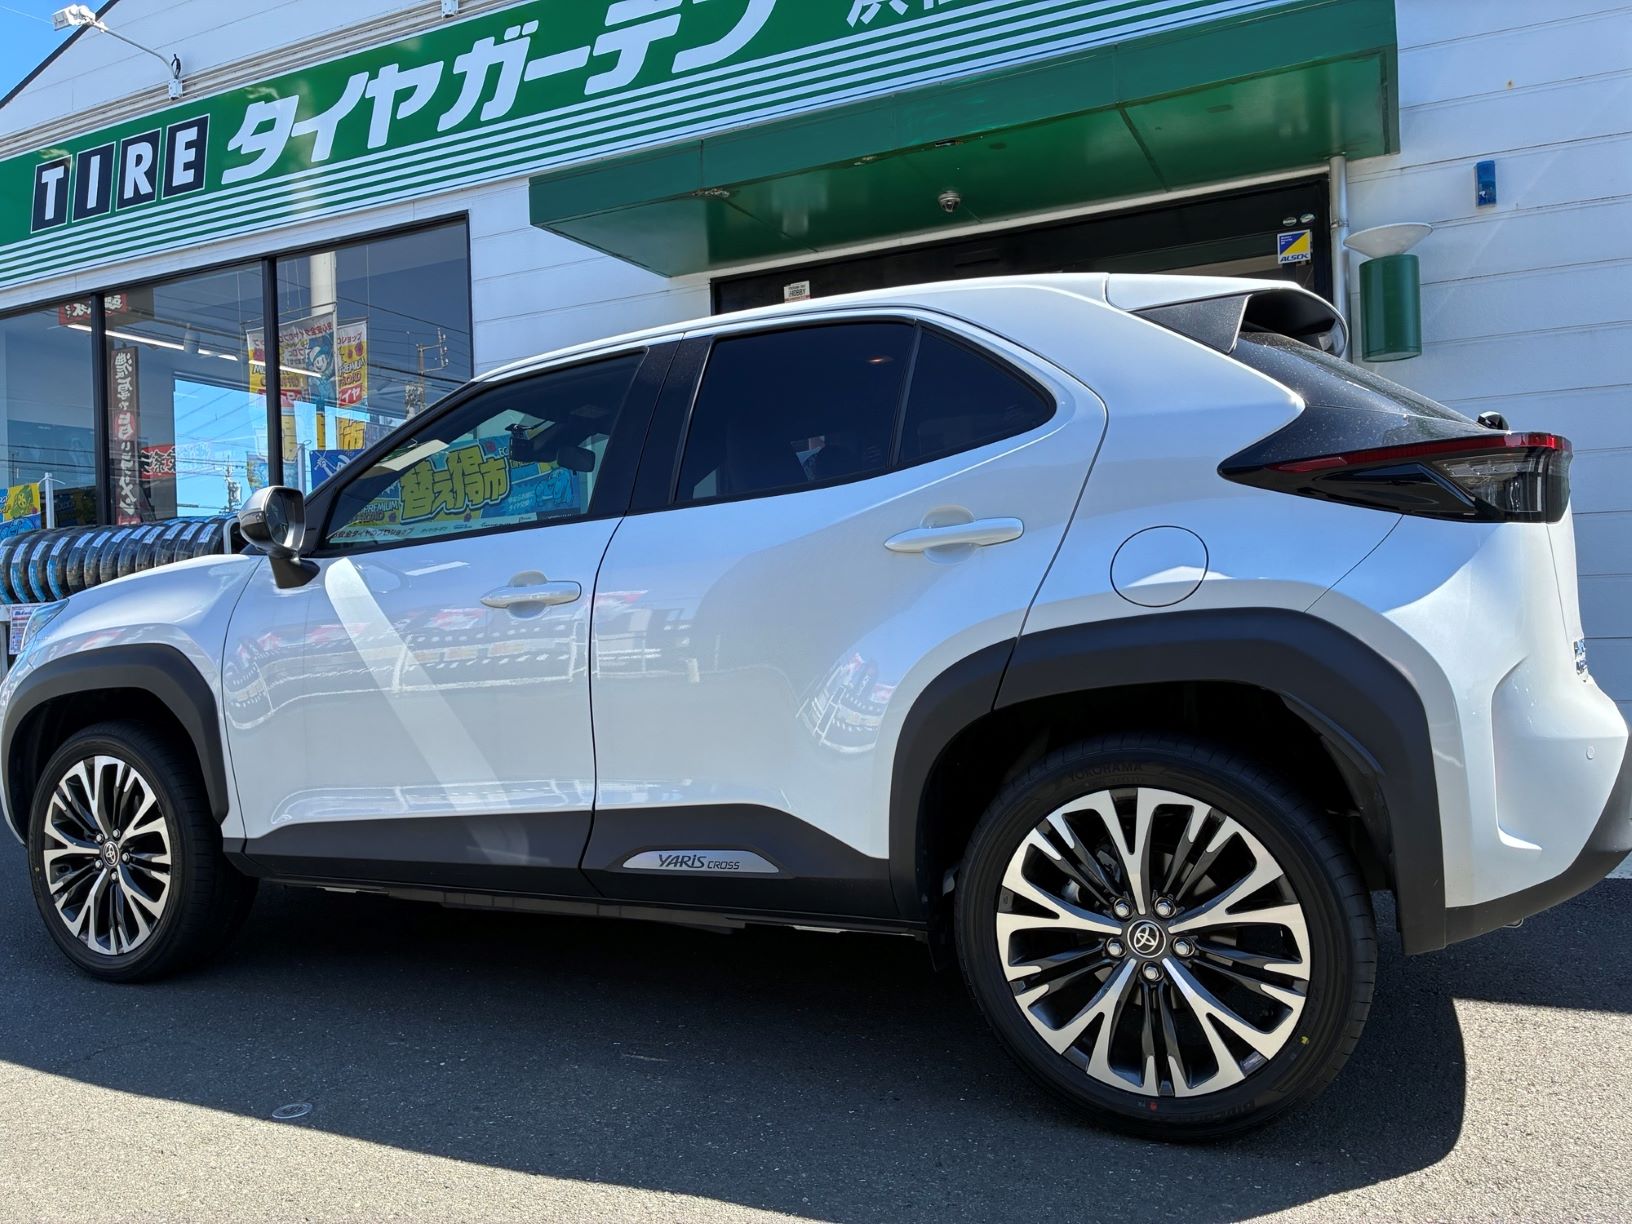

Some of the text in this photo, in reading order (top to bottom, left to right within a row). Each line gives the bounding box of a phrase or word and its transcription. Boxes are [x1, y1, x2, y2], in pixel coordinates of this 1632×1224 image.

[221, 0, 776, 185] タイヤガーデン
[40, 125, 198, 221] TIRE
[1280, 253, 1309, 262] ALSOK
[707, 860, 740, 870] CROSS
